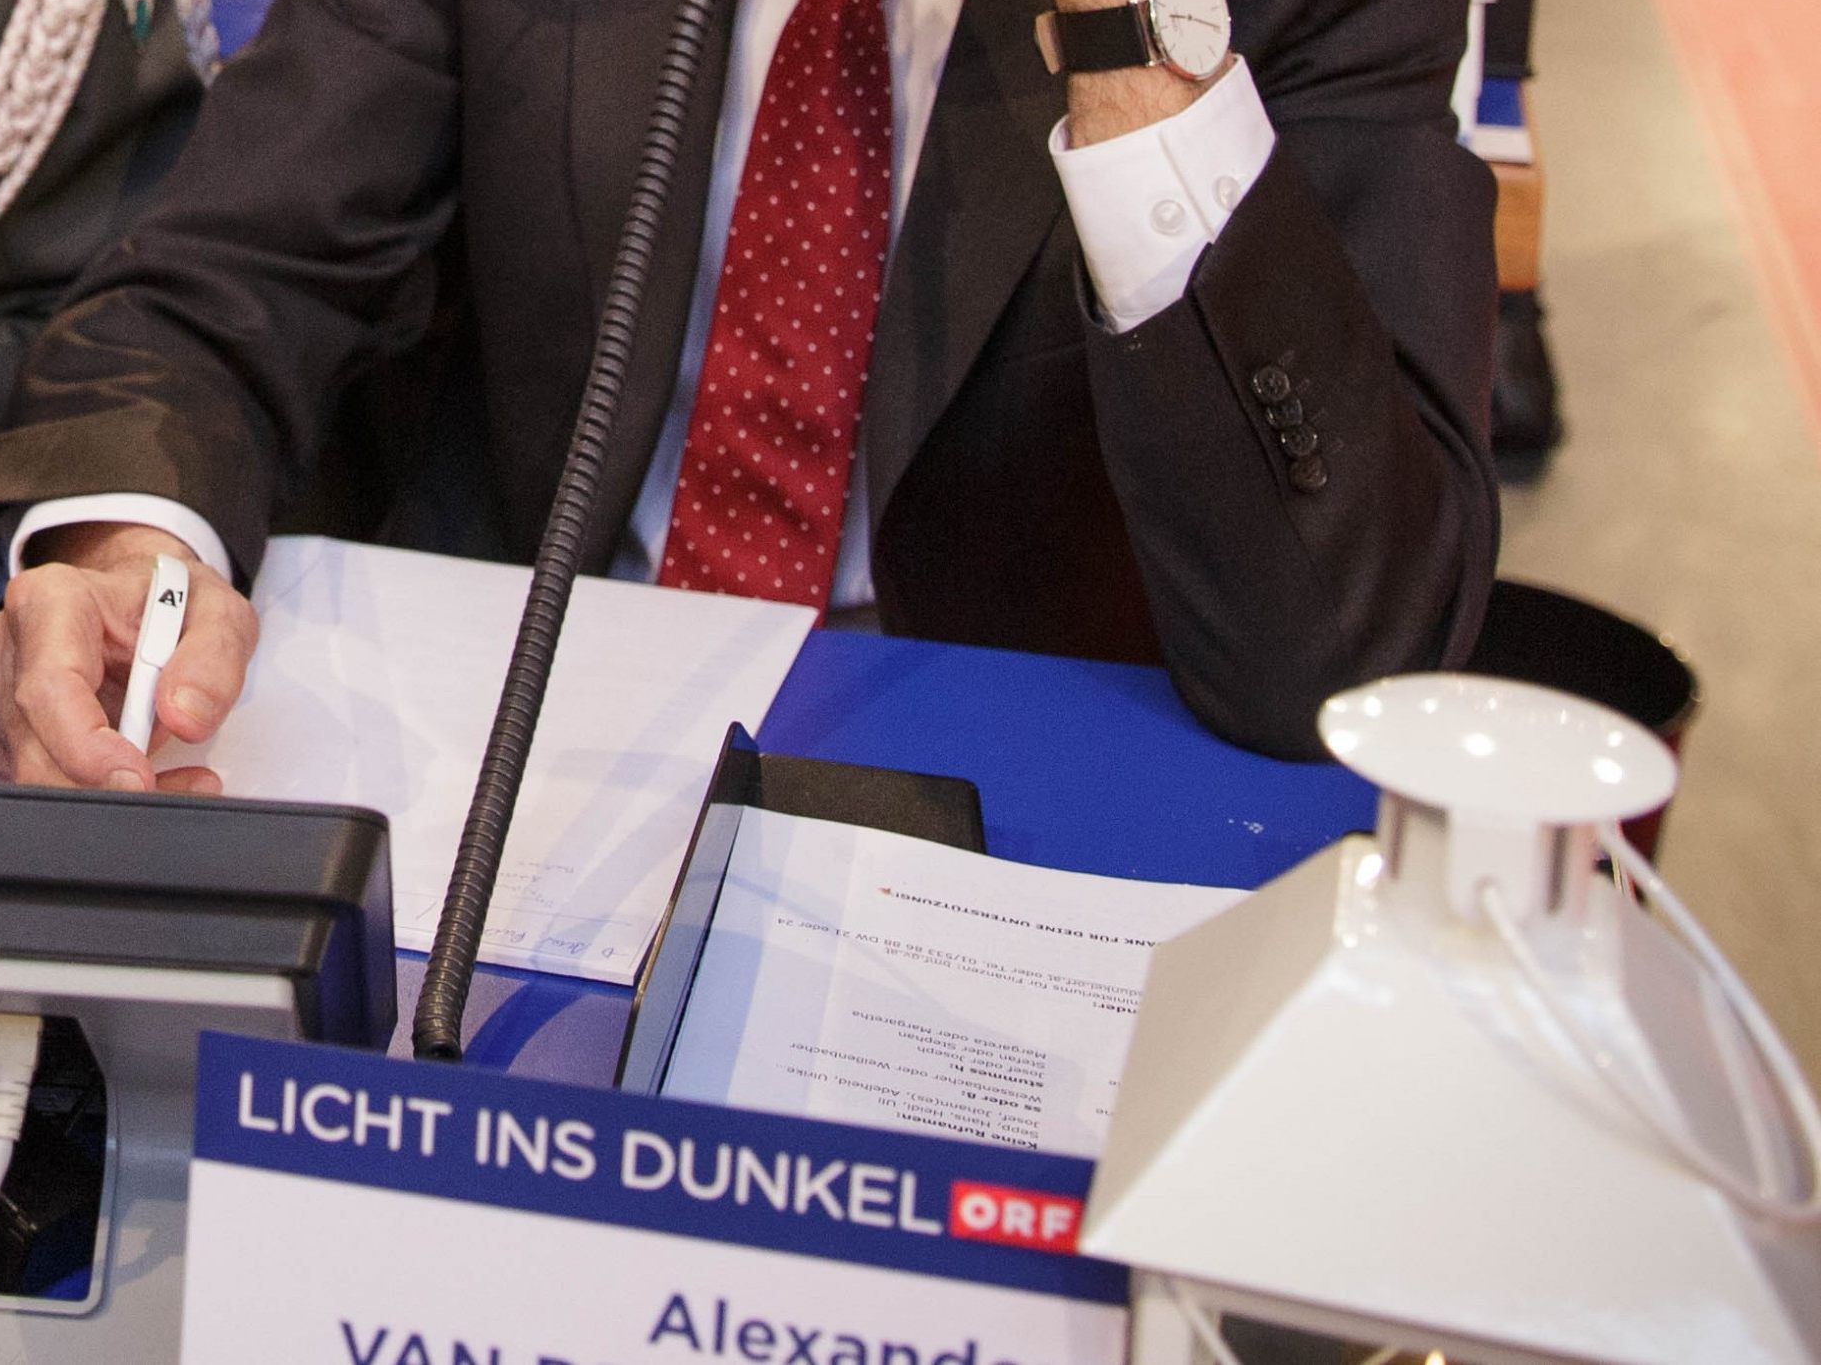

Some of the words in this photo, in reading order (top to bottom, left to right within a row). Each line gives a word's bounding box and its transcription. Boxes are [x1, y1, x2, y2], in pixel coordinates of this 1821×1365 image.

[158, 588, 184, 608] A1
[1035, 923, 1082, 937] DEINE
[1124, 937, 1156, 948] ANK
[1011, 967, 1042, 978] oder
[852, 1009, 930, 1033] Margaretha
[898, 1030, 955, 1049] Stephan
[937, 1029, 967, 1041] oder
[916, 1044, 964, 1061] Joseph
[962, 1045, 993, 1057] oder
[974, 1038, 1045, 1058] Margareta
[972, 1057, 1002, 1069] oder
[999, 1053, 1044, 1068] Stefan
[897, 1065, 927, 1078] oder
[969, 1067, 1043, 1088] stummes
[1008, 1065, 1044, 1078] Josef
[834, 1075, 899, 1096] Adelheid,
[933, 1073, 1041, 1102] Weissenbacher
[902, 1101, 942, 1117] Heidi,
[906, 1091, 991, 1117] Johann(es),
[983, 1095, 1017, 1108] oder
[896, 1111, 984, 1137] Rufnamen:
[950, 1111, 990, 1127] Hans,
[998, 1112, 1039, 1128] Josef,
[997, 1122, 1038, 1138] Sepp,
[991, 1133, 1037, 1149] Keine
[239, 1072, 453, 1157] LICHT
[475, 1108, 598, 1181] INS
[621, 1129, 944, 1236] DUNKEL
[958, 1190, 1077, 1240] ORF
[649, 1292, 1018, 1365] Alexan
